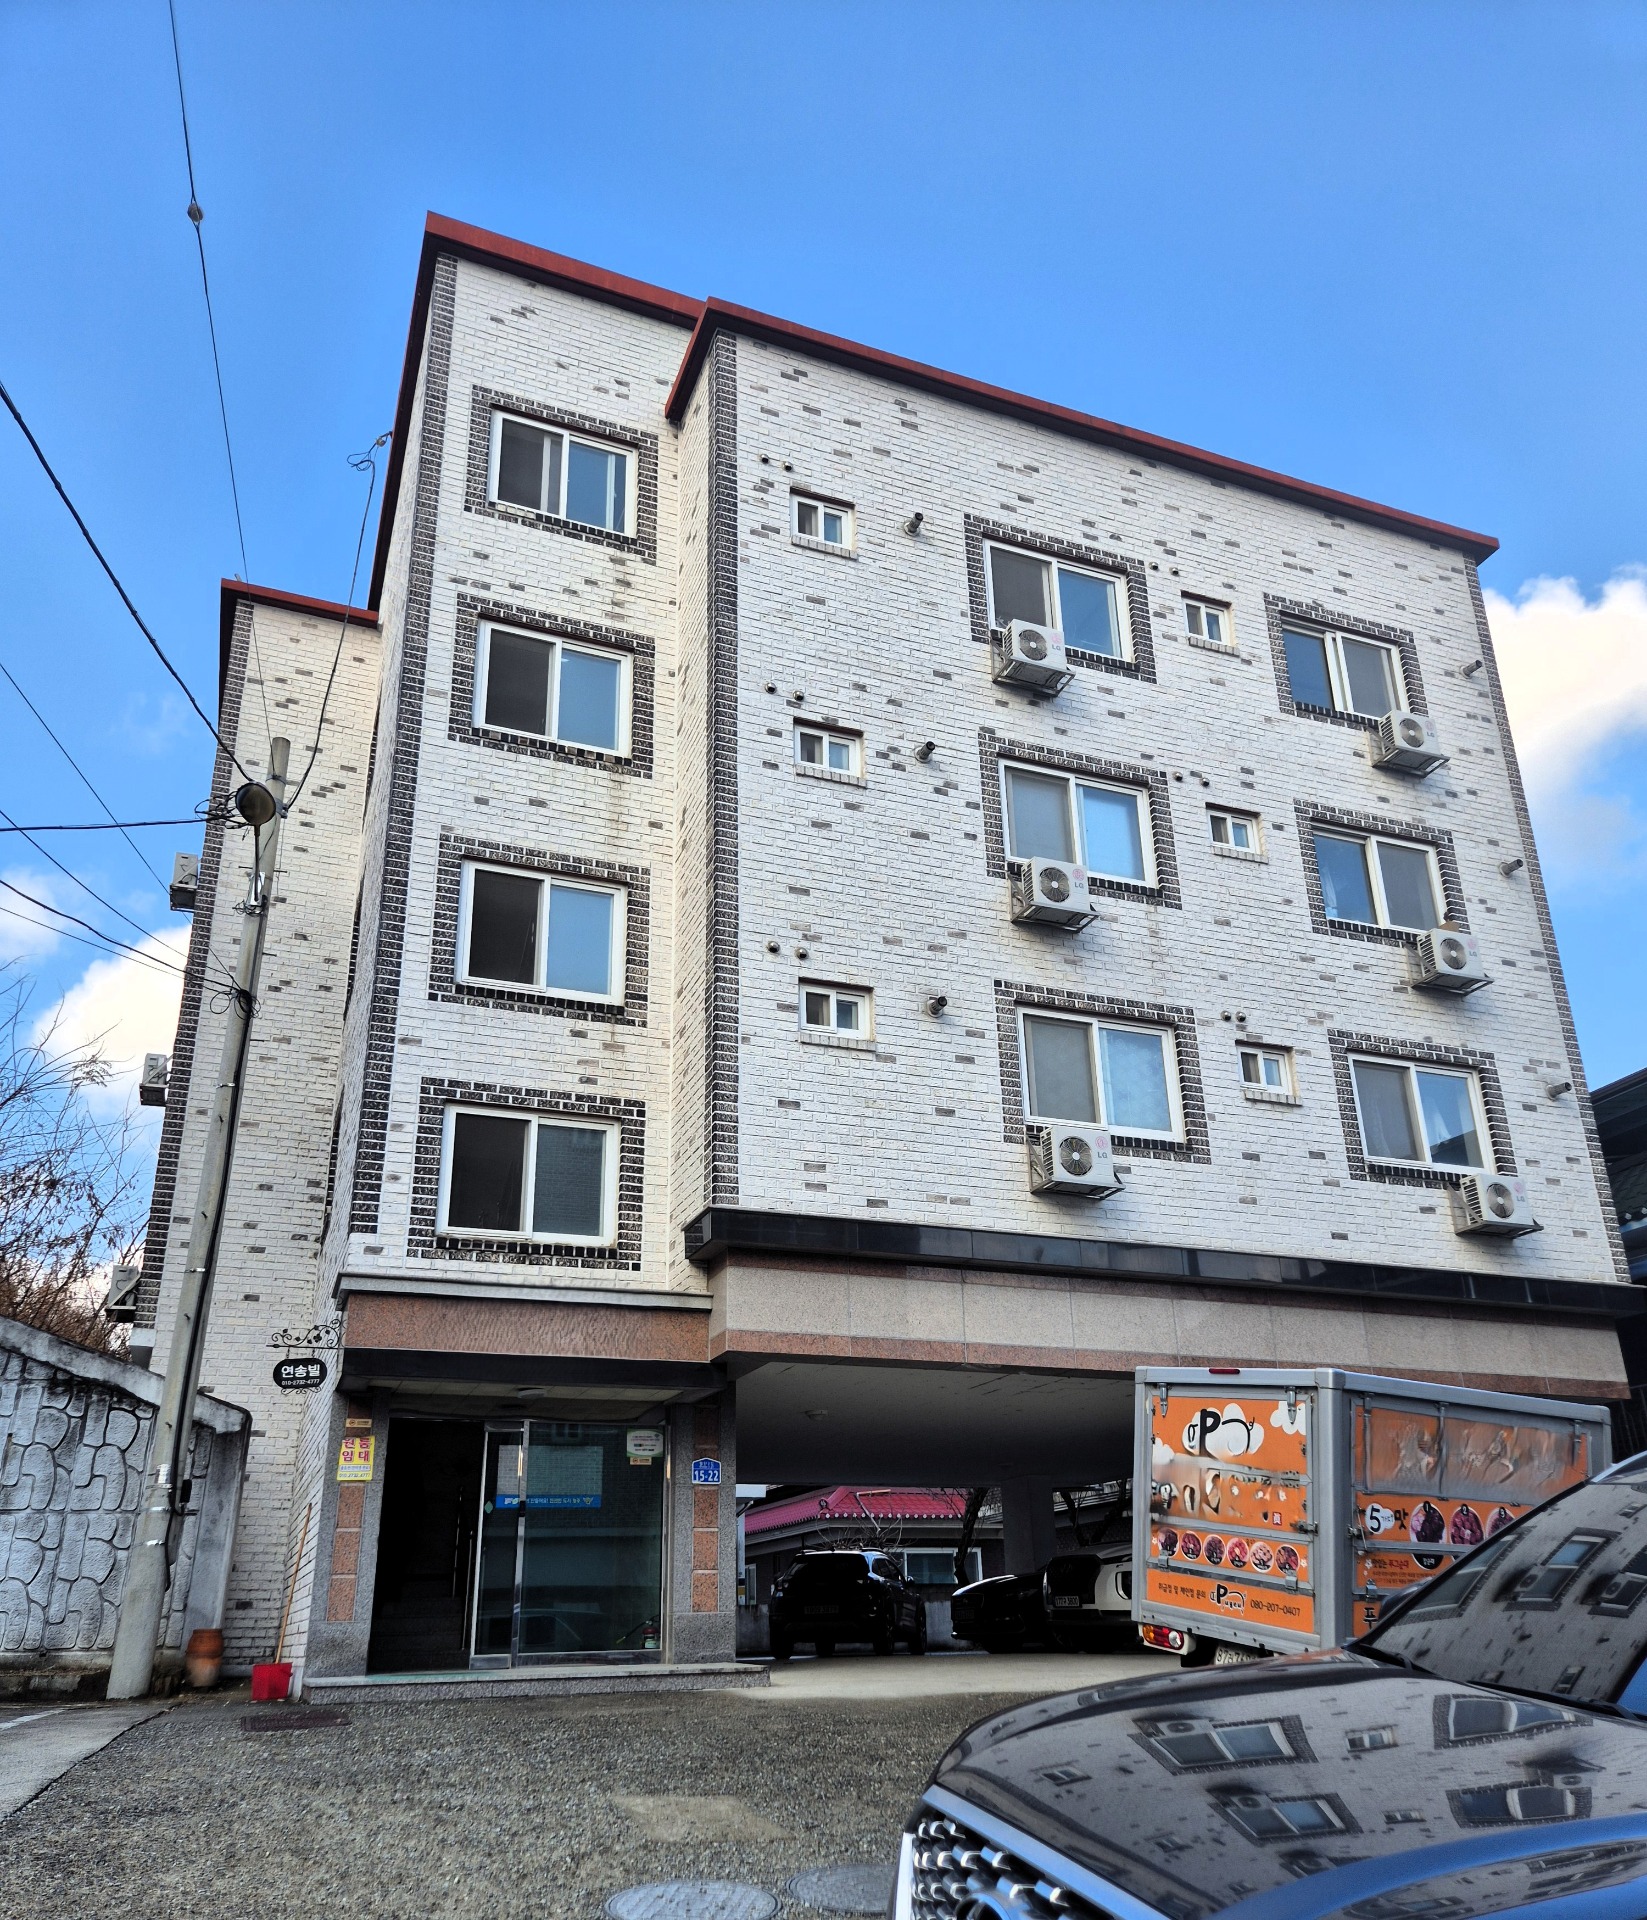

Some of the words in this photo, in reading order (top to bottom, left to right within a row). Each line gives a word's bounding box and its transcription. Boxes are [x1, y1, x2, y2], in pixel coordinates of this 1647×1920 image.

[281, 1364, 320, 1378] 연송빌
[342, 1450, 370, 1462] 임대
[694, 1470, 719, 1482] 15-22
[1394, 1508, 1409, 1530] 맛
[1250, 1599, 1300, 1616] 080-207-0407
